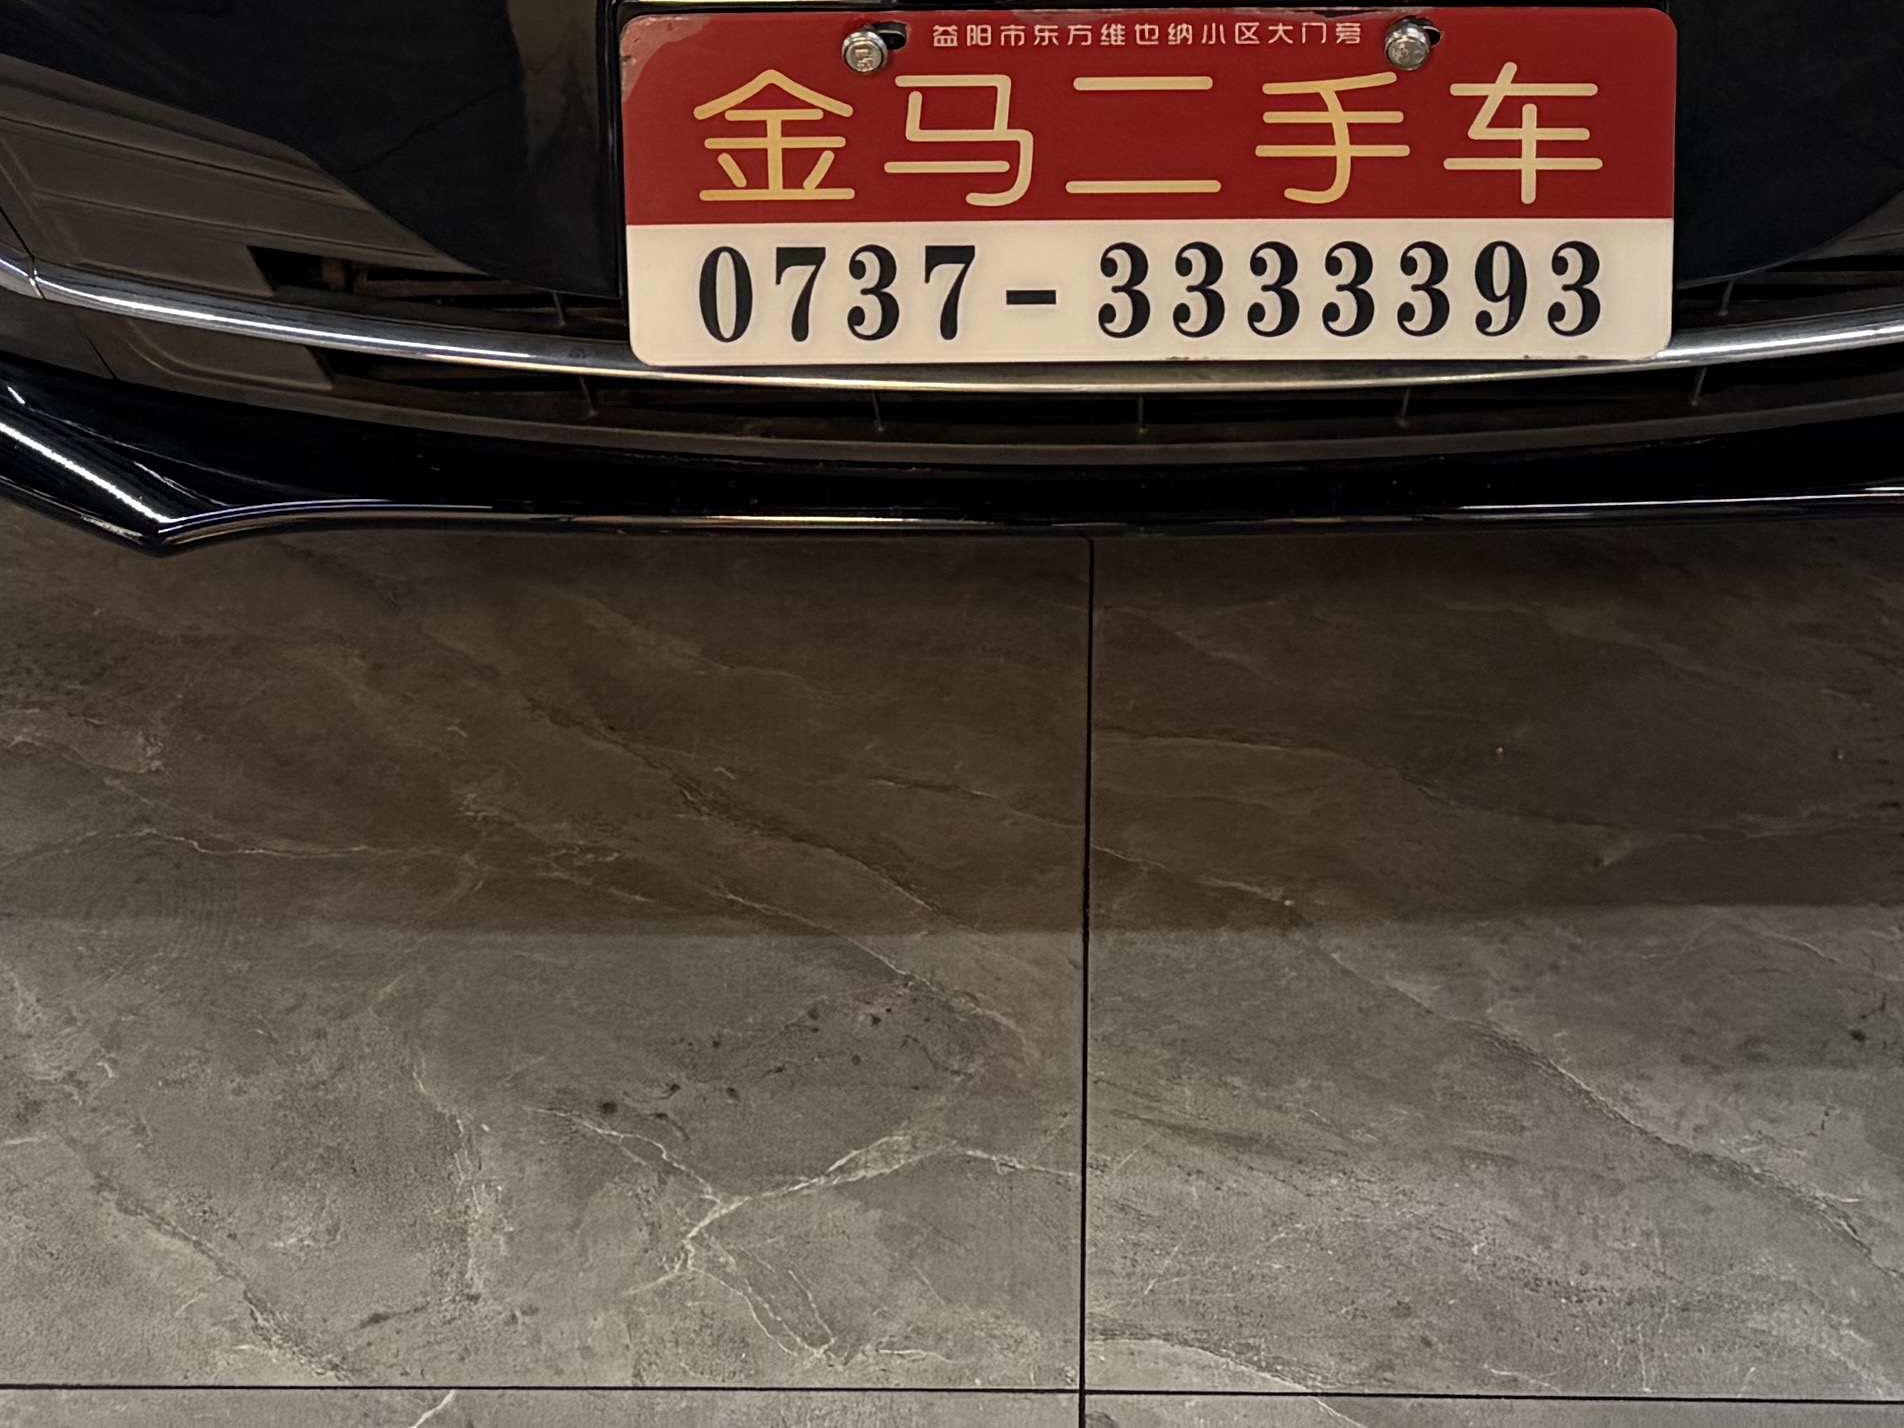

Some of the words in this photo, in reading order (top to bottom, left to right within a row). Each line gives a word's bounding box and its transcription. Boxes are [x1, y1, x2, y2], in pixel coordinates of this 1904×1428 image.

[932, 22, 1362, 48] 益阳市东方维也纳小区大门旁
[693, 61, 1605, 207] 金马二手车
[698, 241, 1603, 344] 0737-3333393
